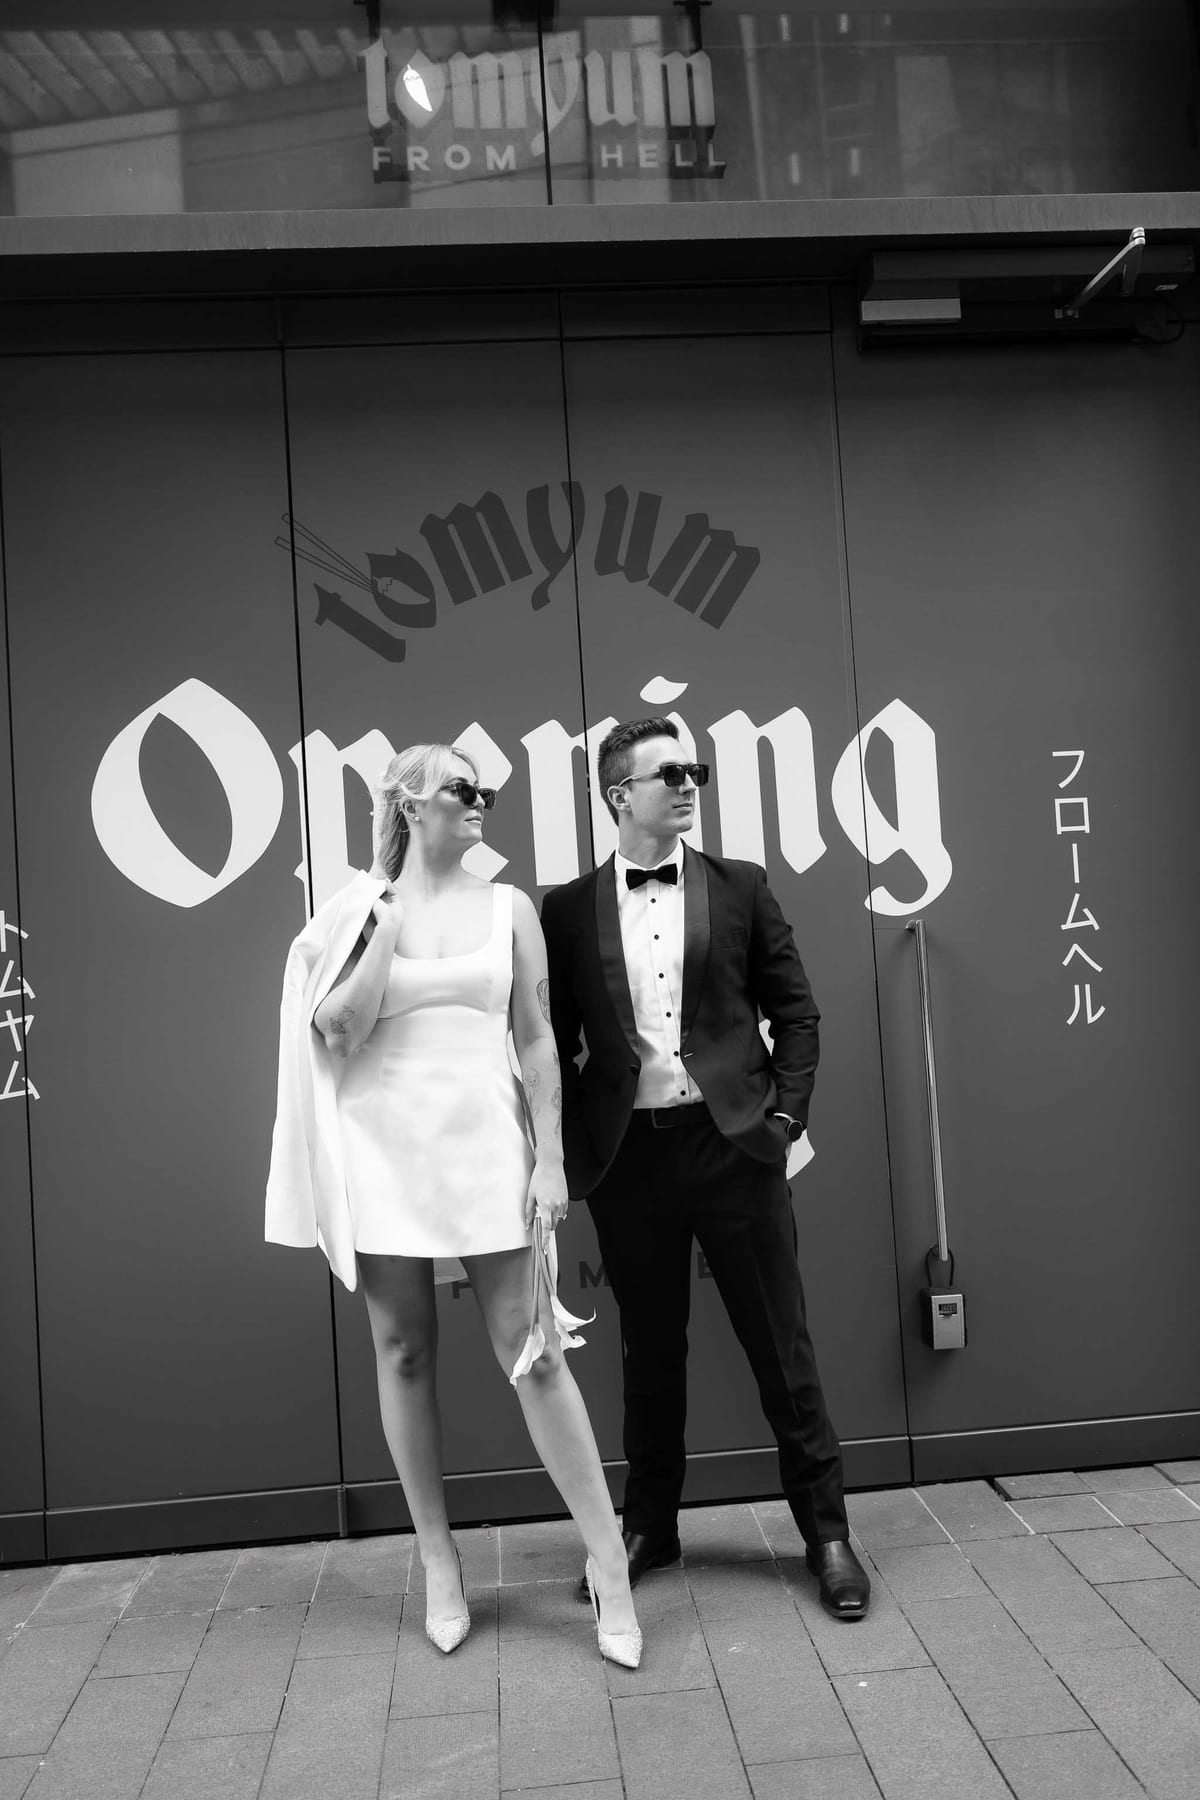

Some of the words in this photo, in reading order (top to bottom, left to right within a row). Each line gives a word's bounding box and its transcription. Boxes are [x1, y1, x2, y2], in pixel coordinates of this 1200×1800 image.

[372, 145, 517, 171] FROM
[601, 143, 726, 169] HELL
[1052, 750, 1106, 1026] フロームヘル
